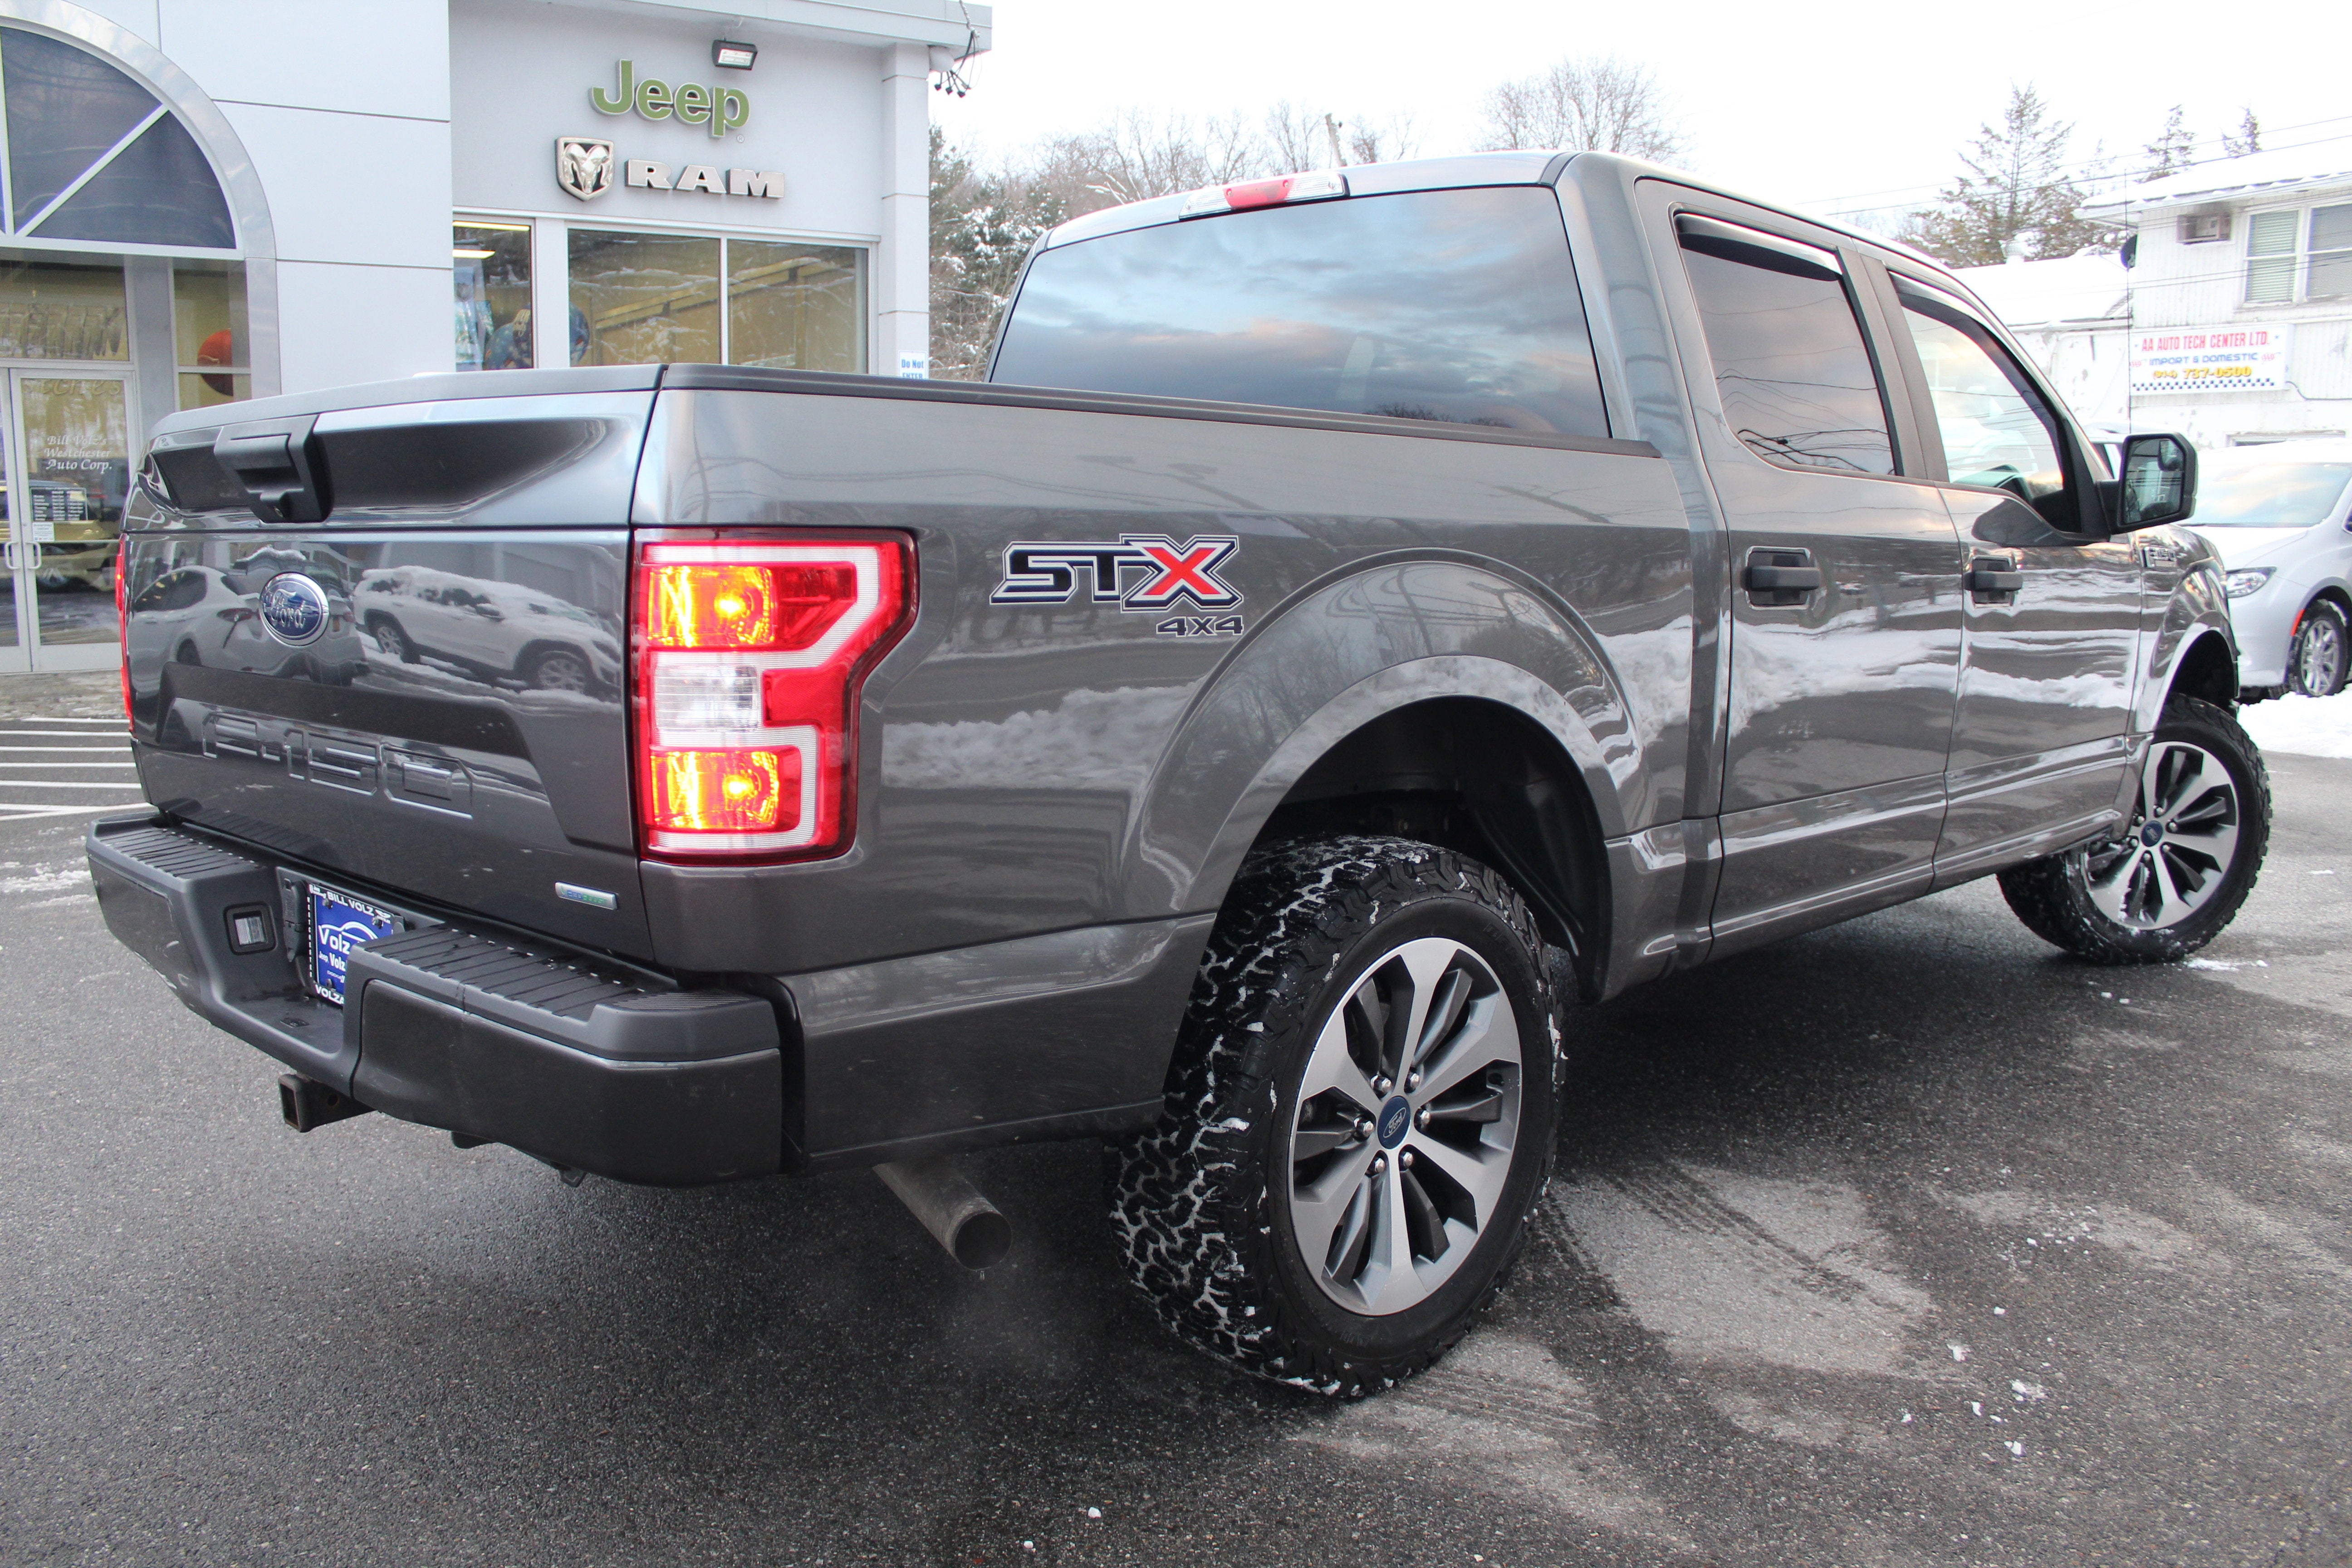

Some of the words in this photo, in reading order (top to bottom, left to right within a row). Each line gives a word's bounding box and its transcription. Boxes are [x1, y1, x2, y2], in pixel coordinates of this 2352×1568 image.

[589, 59, 751, 138] Jeep
[625, 159, 784, 198] RAM
[2141, 338, 2154, 351] AA
[2157, 336, 2180, 351] AUTO
[2183, 335, 2205, 349] TECH
[2210, 333, 2246, 348] CENTER
[902, 359, 910, 368] Do
[912, 359, 924, 368] Not
[2150, 356, 2189, 366] IMPORT
[2202, 353, 2258, 363] DOMESTIC
[2153, 370, 2178, 379] (914)
[2183, 366, 2251, 379] 737-0500
[47, 436, 69, 445] Bill
[44, 447, 111, 457] Westchester
[46, 459, 78, 470] Auto
[81, 459, 113, 474] Corp.
[990, 533, 1244, 613] STX
[271, 588, 308, 629] Ford
[327, 891, 348, 906] BILL
[348, 899, 374, 916] VOLZ
[318, 925, 351, 955] Volz
[329, 952, 347, 972] Volz
[1388, 1112, 1403, 1134] Ford
